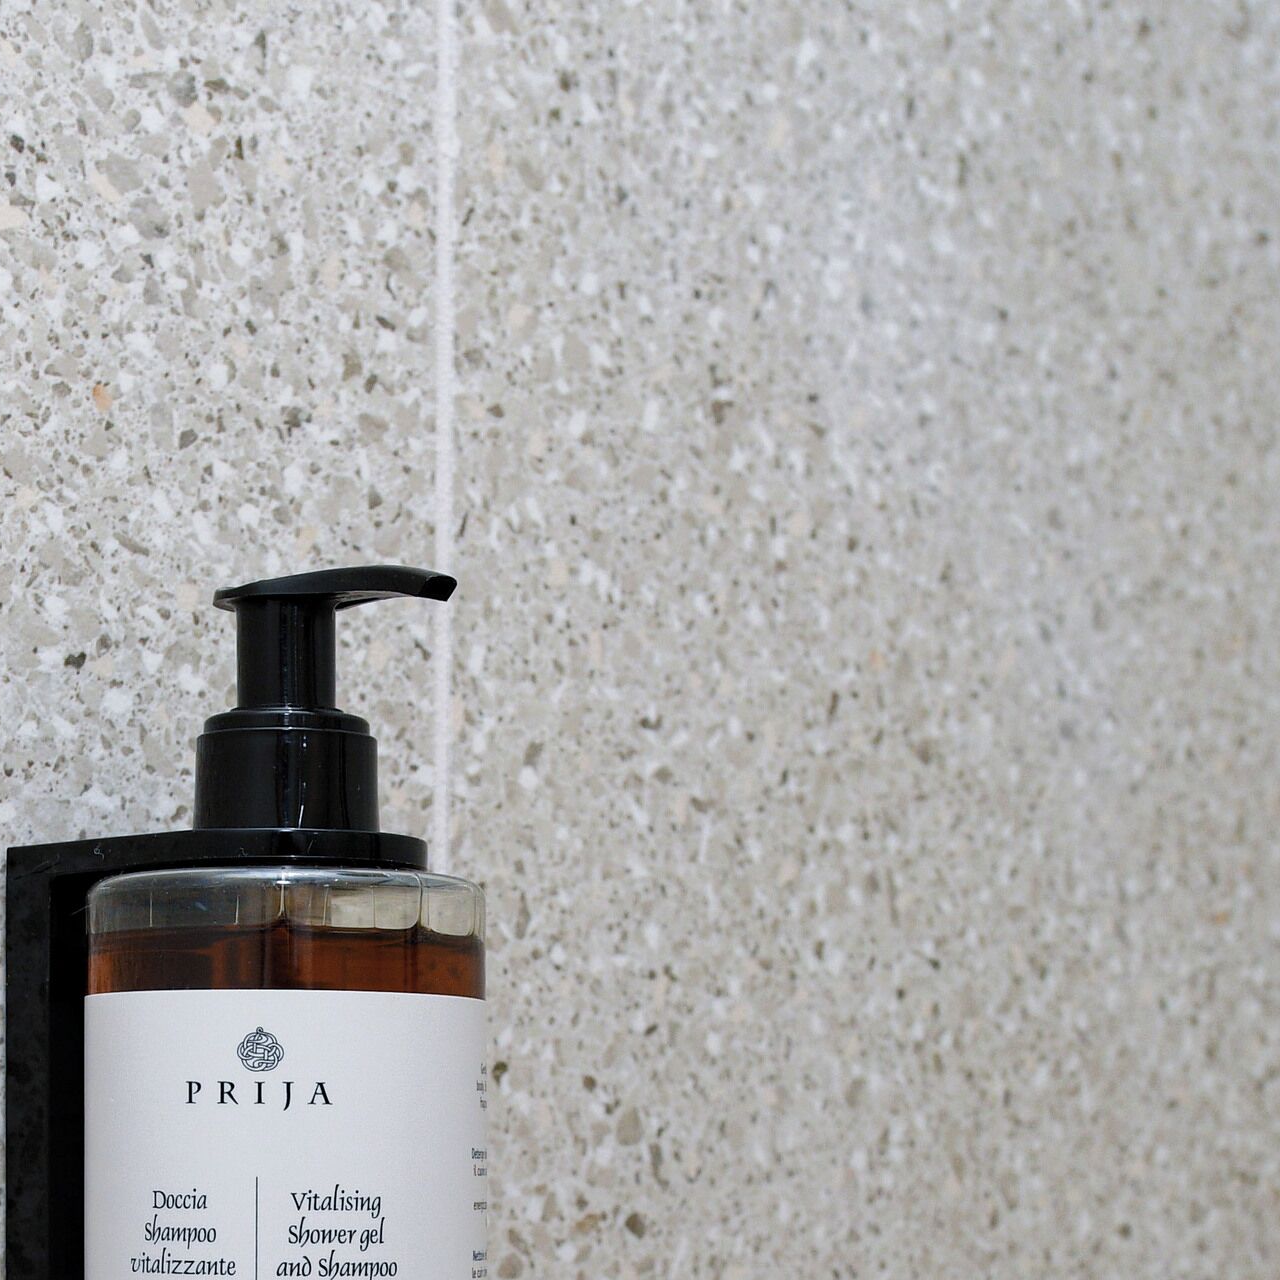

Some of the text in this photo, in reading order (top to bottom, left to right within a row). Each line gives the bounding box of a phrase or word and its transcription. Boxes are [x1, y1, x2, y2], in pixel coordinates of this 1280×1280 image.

[184, 1080, 334, 1112] PRIJA
[151, 1187, 208, 1210] Doccia
[289, 1183, 382, 1220] Vitalising
[144, 1213, 217, 1251] Shampoo
[287, 1215, 386, 1253] Shower gel
[130, 1246, 237, 1277] vitalizzante
[275, 1255, 313, 1278] and
